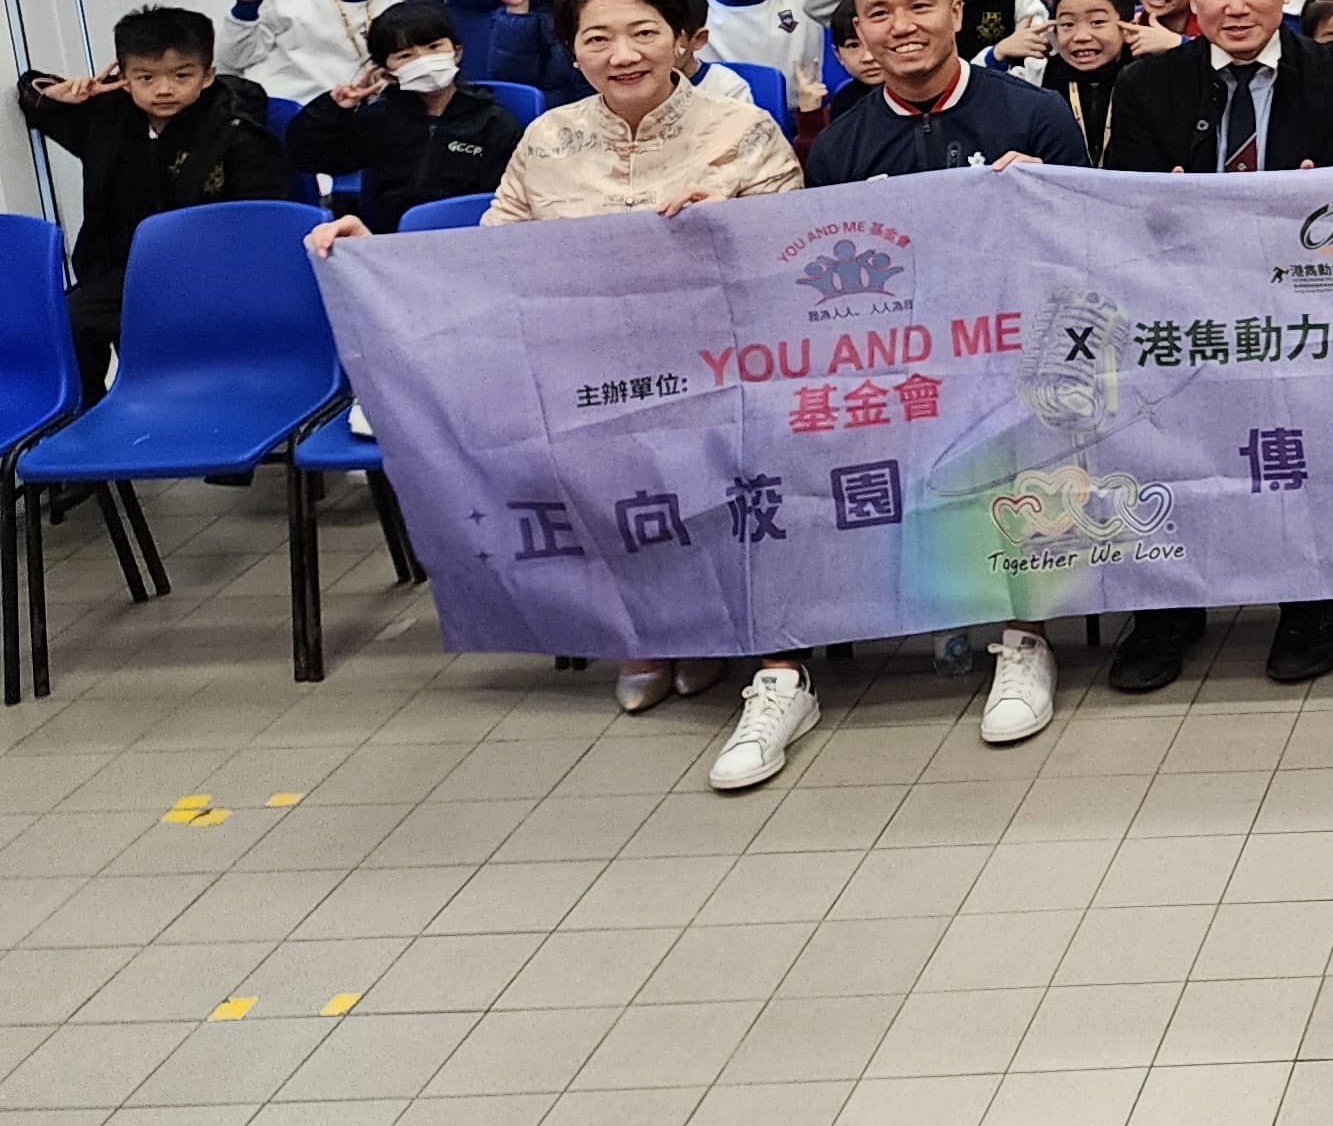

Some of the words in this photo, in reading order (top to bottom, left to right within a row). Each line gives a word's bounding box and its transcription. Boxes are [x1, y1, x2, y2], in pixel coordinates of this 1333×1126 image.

[777, 237, 806, 264] YOU
[807, 223, 839, 243] AND
[843, 221, 865, 233] ME
[576, 372, 689, 409] 主辦單位:
[700, 339, 811, 386] YOU
[827, 326, 933, 373] AND
[951, 312, 1023, 359] ME
[1064, 326, 1095, 362] X
[789, 374, 943, 435] 基金會
[507, 460, 902, 562] 正向校園
[988, 550, 1077, 574] Together
[1090, 542, 1128, 565] We
[1134, 539, 1186, 561] Love
